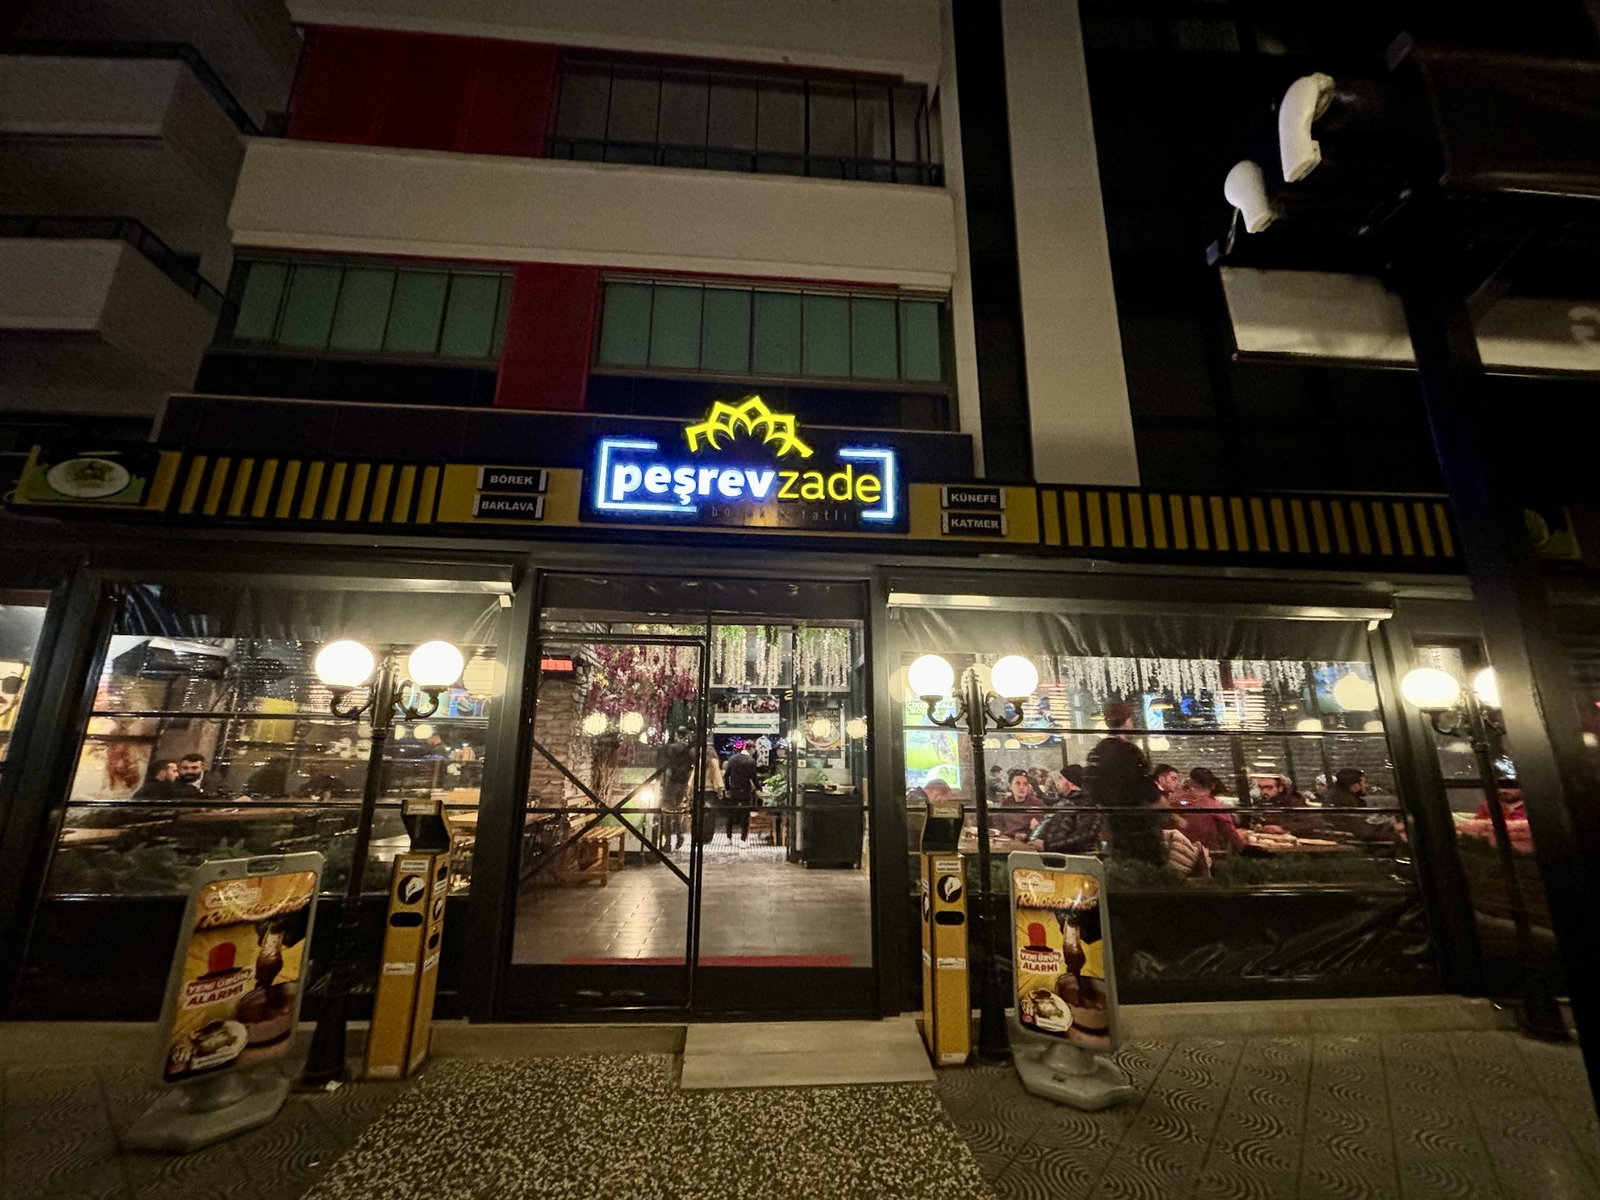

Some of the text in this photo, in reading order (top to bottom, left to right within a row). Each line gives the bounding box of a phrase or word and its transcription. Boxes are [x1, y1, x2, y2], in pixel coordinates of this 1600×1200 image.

[490, 474, 533, 485] BÖREK
[951, 492, 998, 504] KÜNEFE
[481, 501, 534, 511] BAKLAVA
[951, 518, 1000, 529] KATMER
